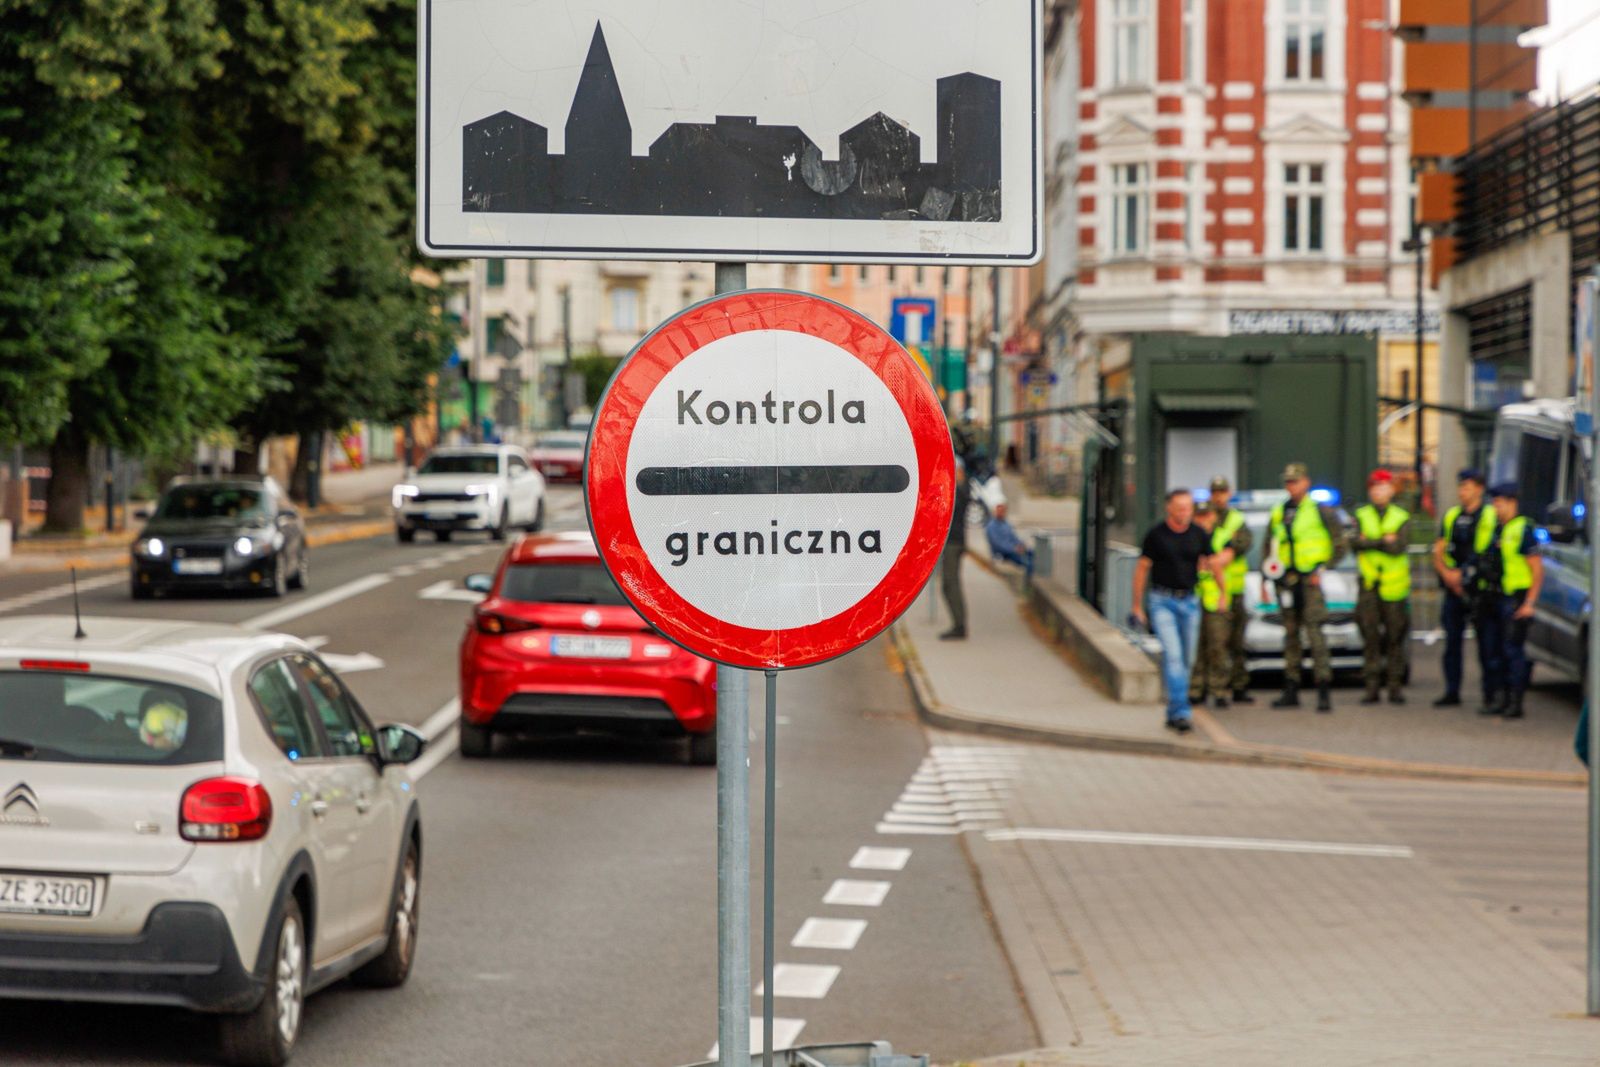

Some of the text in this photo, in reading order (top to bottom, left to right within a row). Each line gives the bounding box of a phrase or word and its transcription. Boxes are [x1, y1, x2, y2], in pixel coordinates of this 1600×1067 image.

[677, 389, 866, 425] Kontrola
[666, 520, 882, 567] graniczna
[34, 881, 88, 906] 2300
